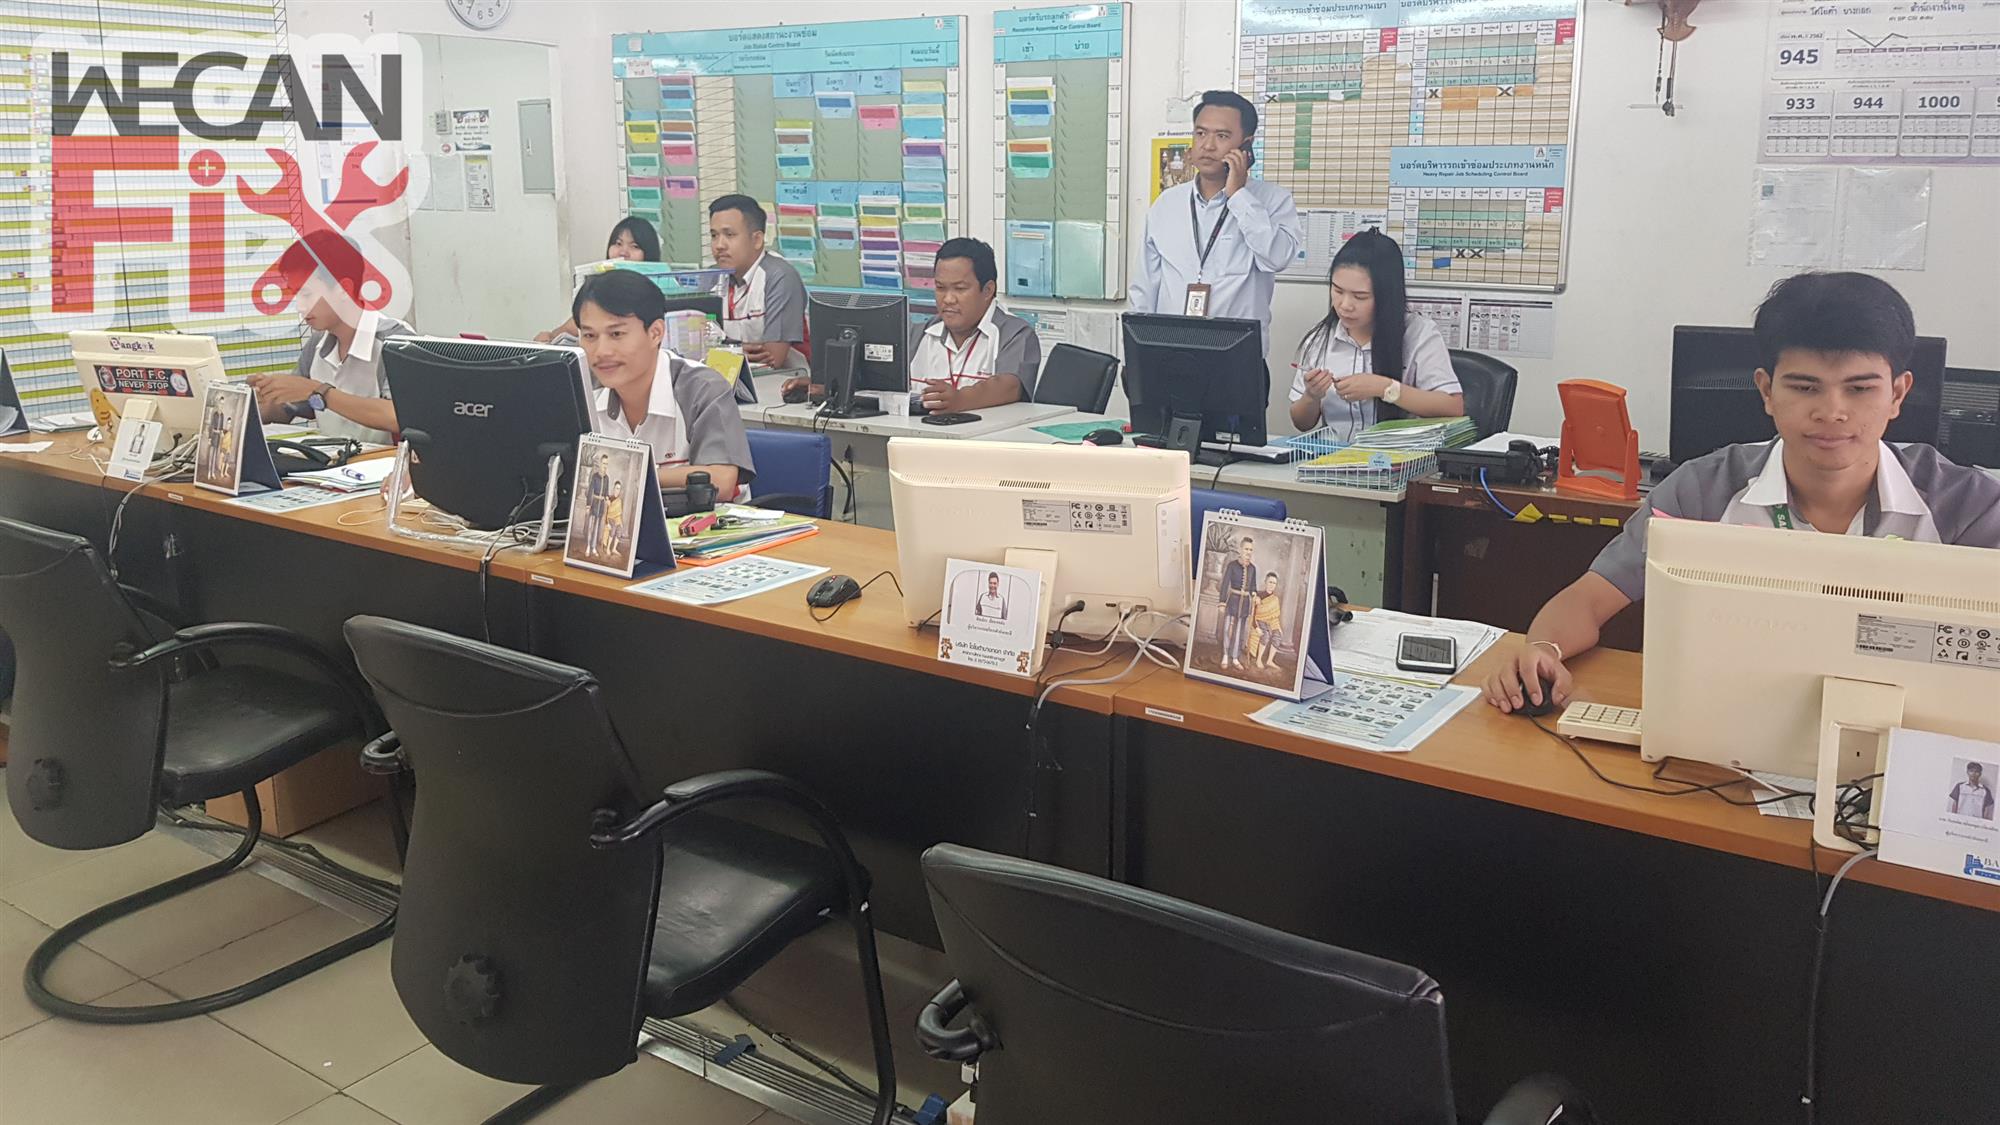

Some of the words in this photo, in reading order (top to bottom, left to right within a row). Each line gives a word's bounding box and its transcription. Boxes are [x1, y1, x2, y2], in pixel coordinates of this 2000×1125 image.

[1780, 49, 1819, 65] 945
[1786, 98, 1815, 110] 933
[1853, 97, 1884, 109] 944
[1918, 95, 1961, 109] 1000
[116, 368, 144, 379] PORT
[148, 370, 169, 380] F.C.
[118, 380, 145, 389] NEVER
[148, 382, 169, 390] STOP
[453, 401, 494, 417] acer
